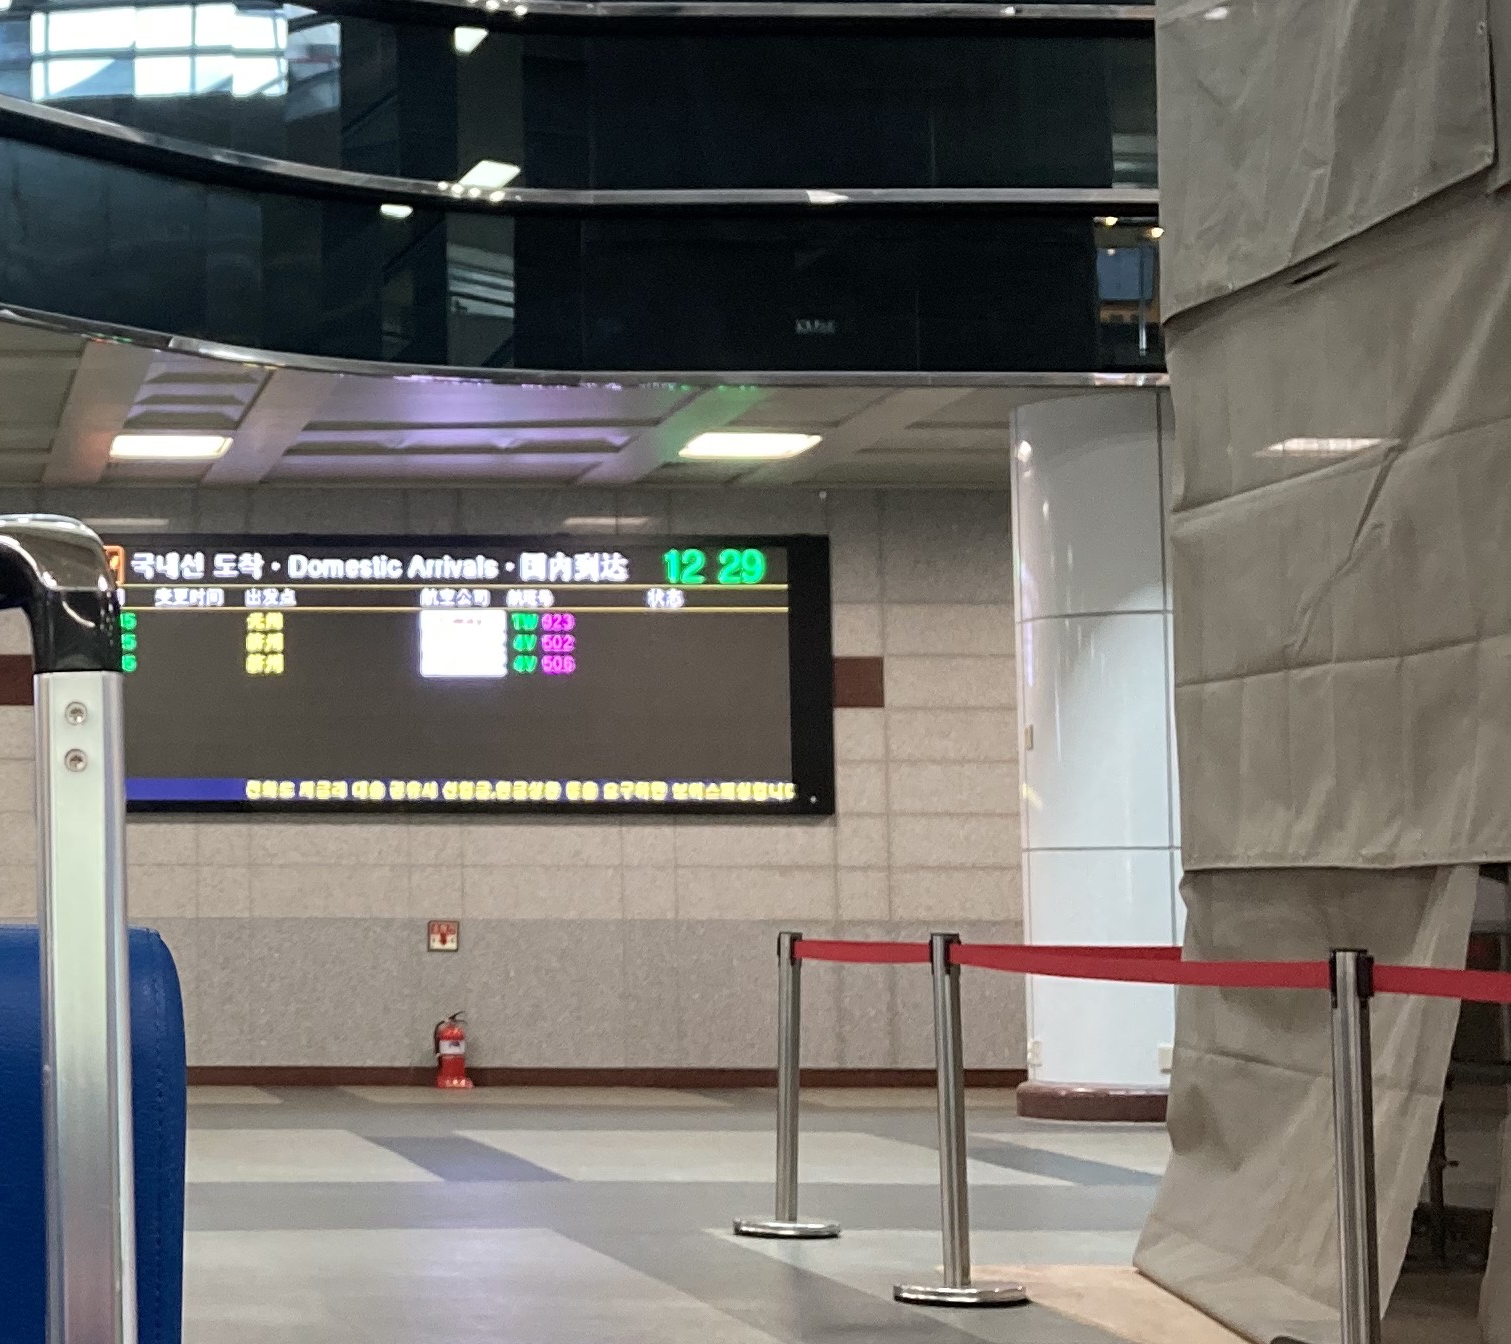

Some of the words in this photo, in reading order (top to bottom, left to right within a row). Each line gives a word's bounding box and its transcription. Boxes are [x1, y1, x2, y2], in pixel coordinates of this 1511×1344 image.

[130, 551, 205, 580] 국내선
[213, 551, 265, 580] 도착
[287, 553, 403, 579] Domestic
[407, 554, 499, 579] Arrivals
[664, 548, 706, 584] 12
[719, 548, 765, 584] 29
[541, 633, 576, 652] 502
